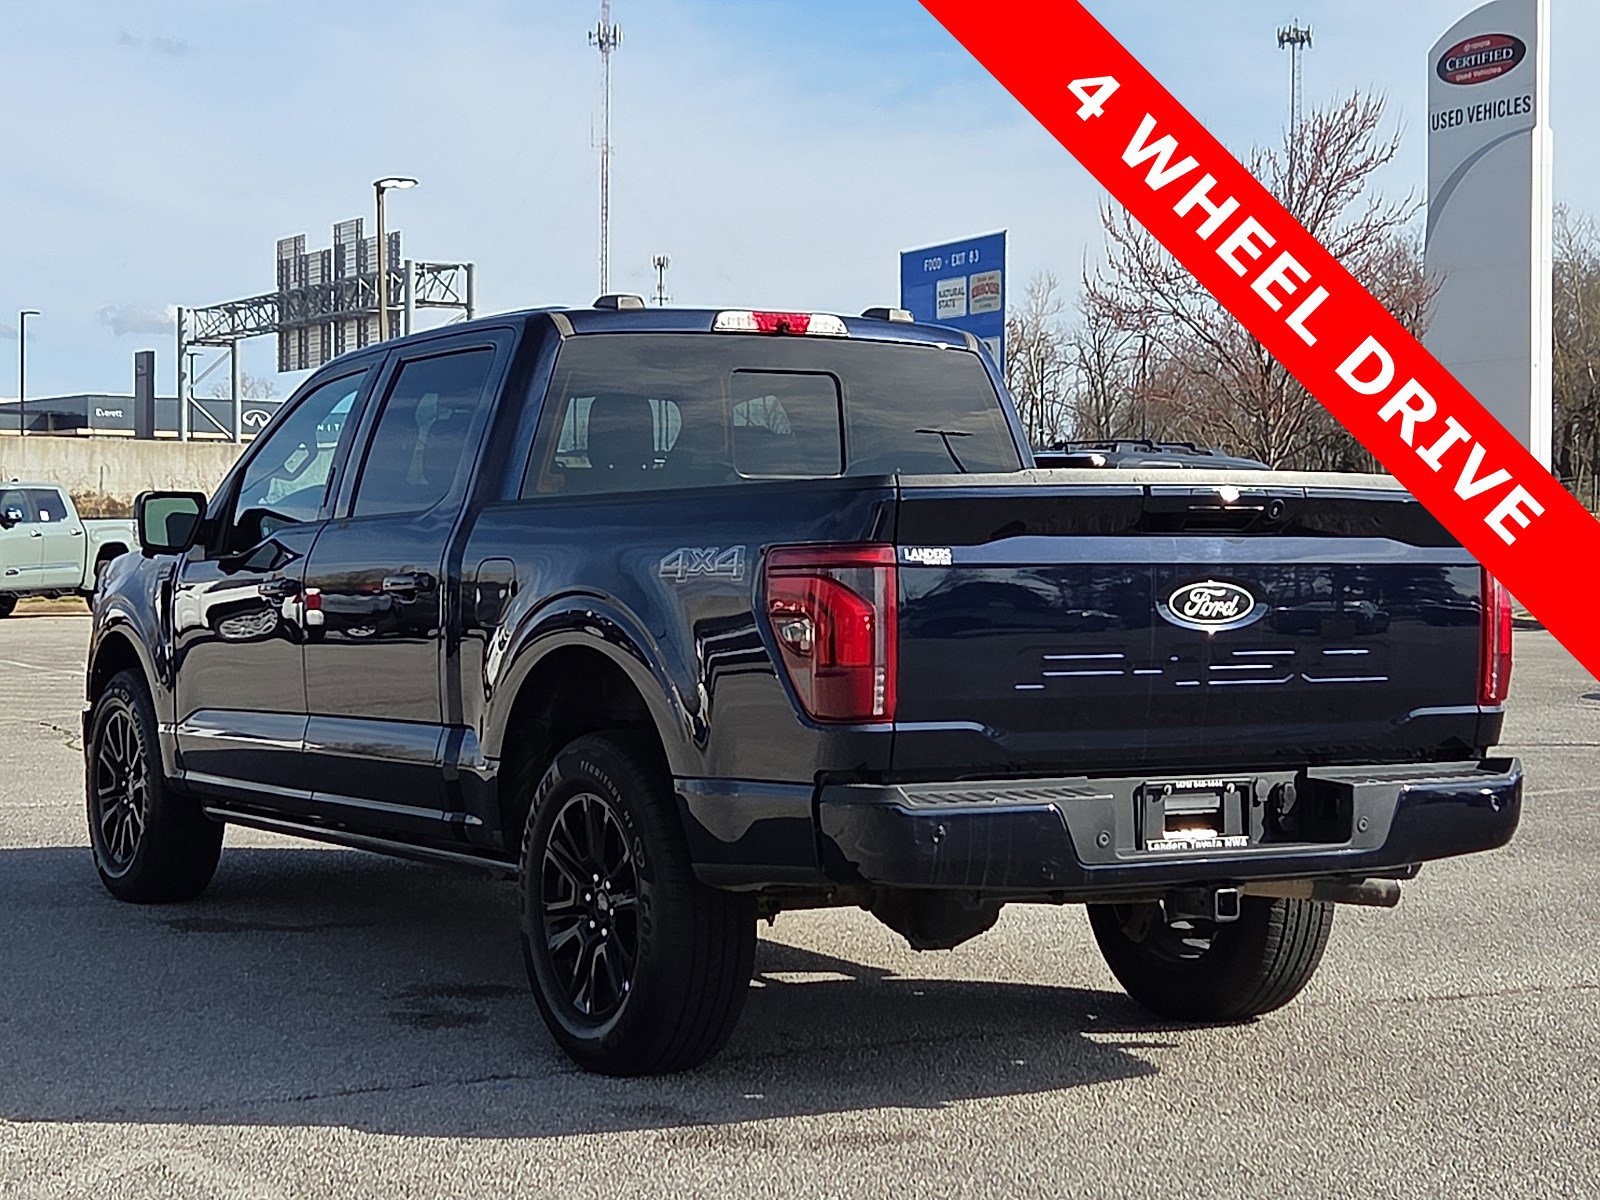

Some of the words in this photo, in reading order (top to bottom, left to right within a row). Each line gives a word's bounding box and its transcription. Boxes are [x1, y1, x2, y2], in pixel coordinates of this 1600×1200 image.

[1445, 48, 1514, 72] CERTIFIED
[1431, 108, 1464, 131] USED
[1467, 95, 1531, 124] VEHICLES
[924, 257, 942, 272] FOOD
[951, 251, 966, 267] EXIT
[903, 547, 952, 561] LANDERS
[1184, 588, 1240, 617] Ford
